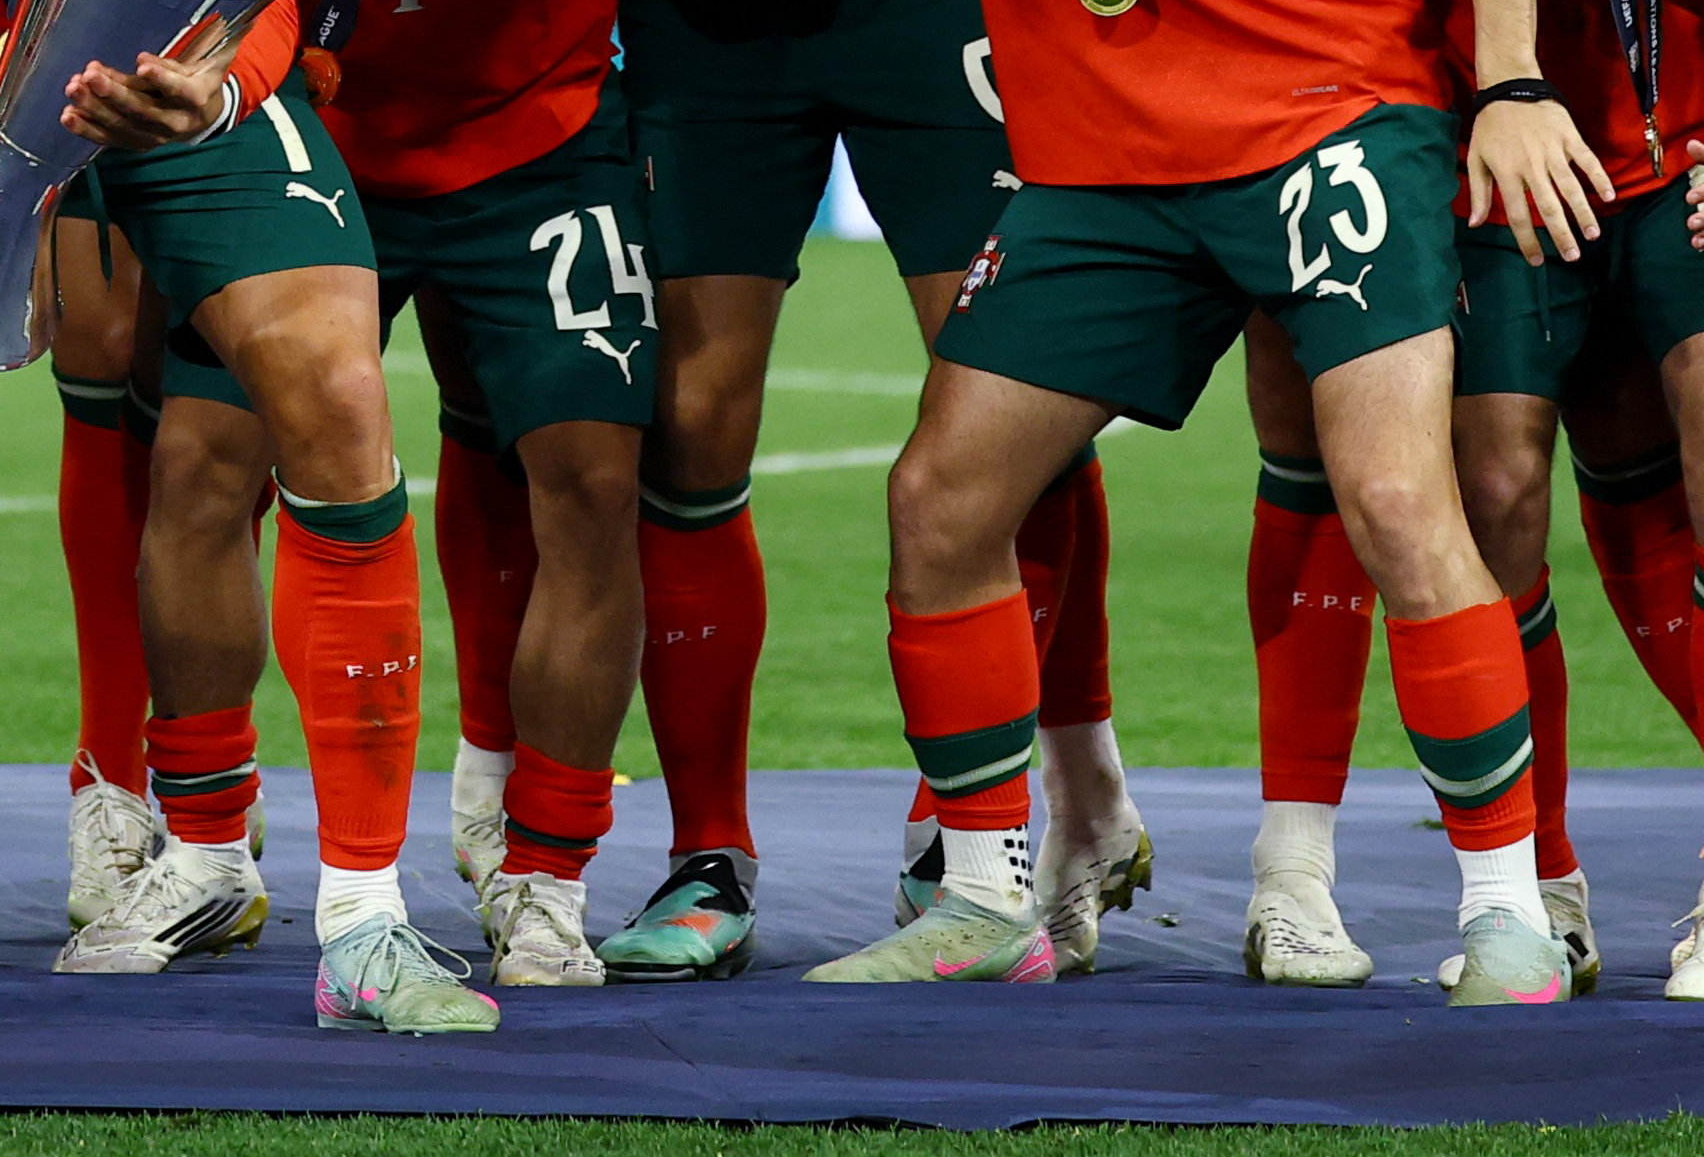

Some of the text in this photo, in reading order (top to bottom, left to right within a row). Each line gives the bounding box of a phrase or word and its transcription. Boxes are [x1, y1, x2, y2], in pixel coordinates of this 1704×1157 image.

[318, 5, 340, 47] AGUE
[529, 204, 659, 331] 24
[1279, 140, 1388, 293] 23
